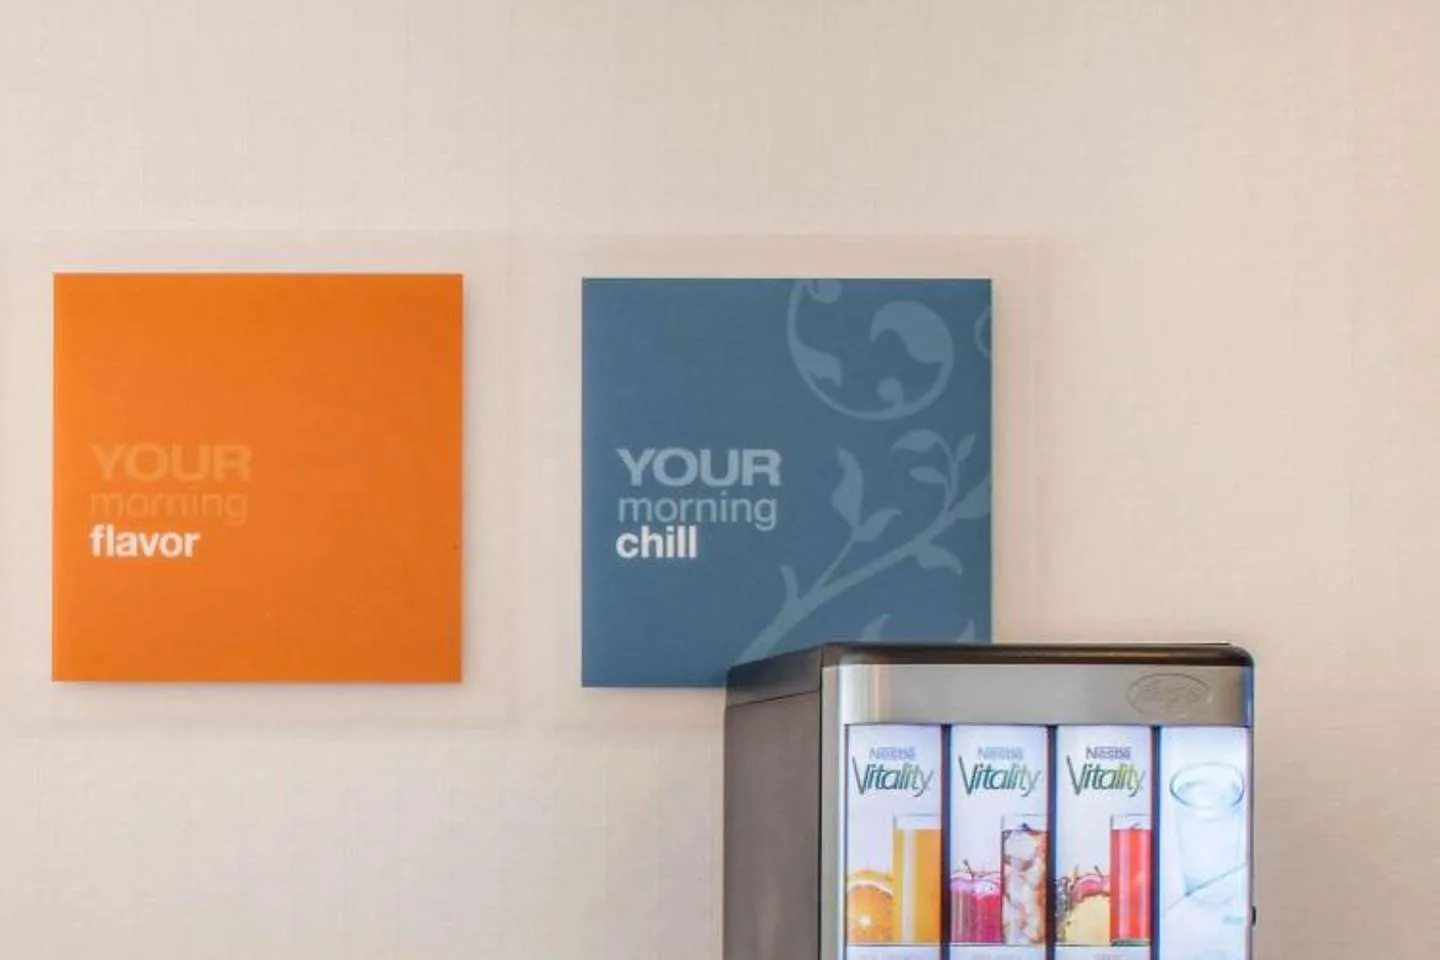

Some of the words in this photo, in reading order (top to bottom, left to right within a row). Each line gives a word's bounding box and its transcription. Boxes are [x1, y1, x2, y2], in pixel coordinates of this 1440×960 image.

[91, 443, 252, 482] YOUR
[616, 447, 781, 487] YOUR
[90, 487, 248, 527] morning
[618, 490, 777, 532] morning
[89, 523, 201, 559] flavor
[615, 525, 698, 559] chill
[851, 755, 935, 798] Vitality
[957, 755, 1042, 798] Vitality
[1066, 754, 1146, 798] Vitality
